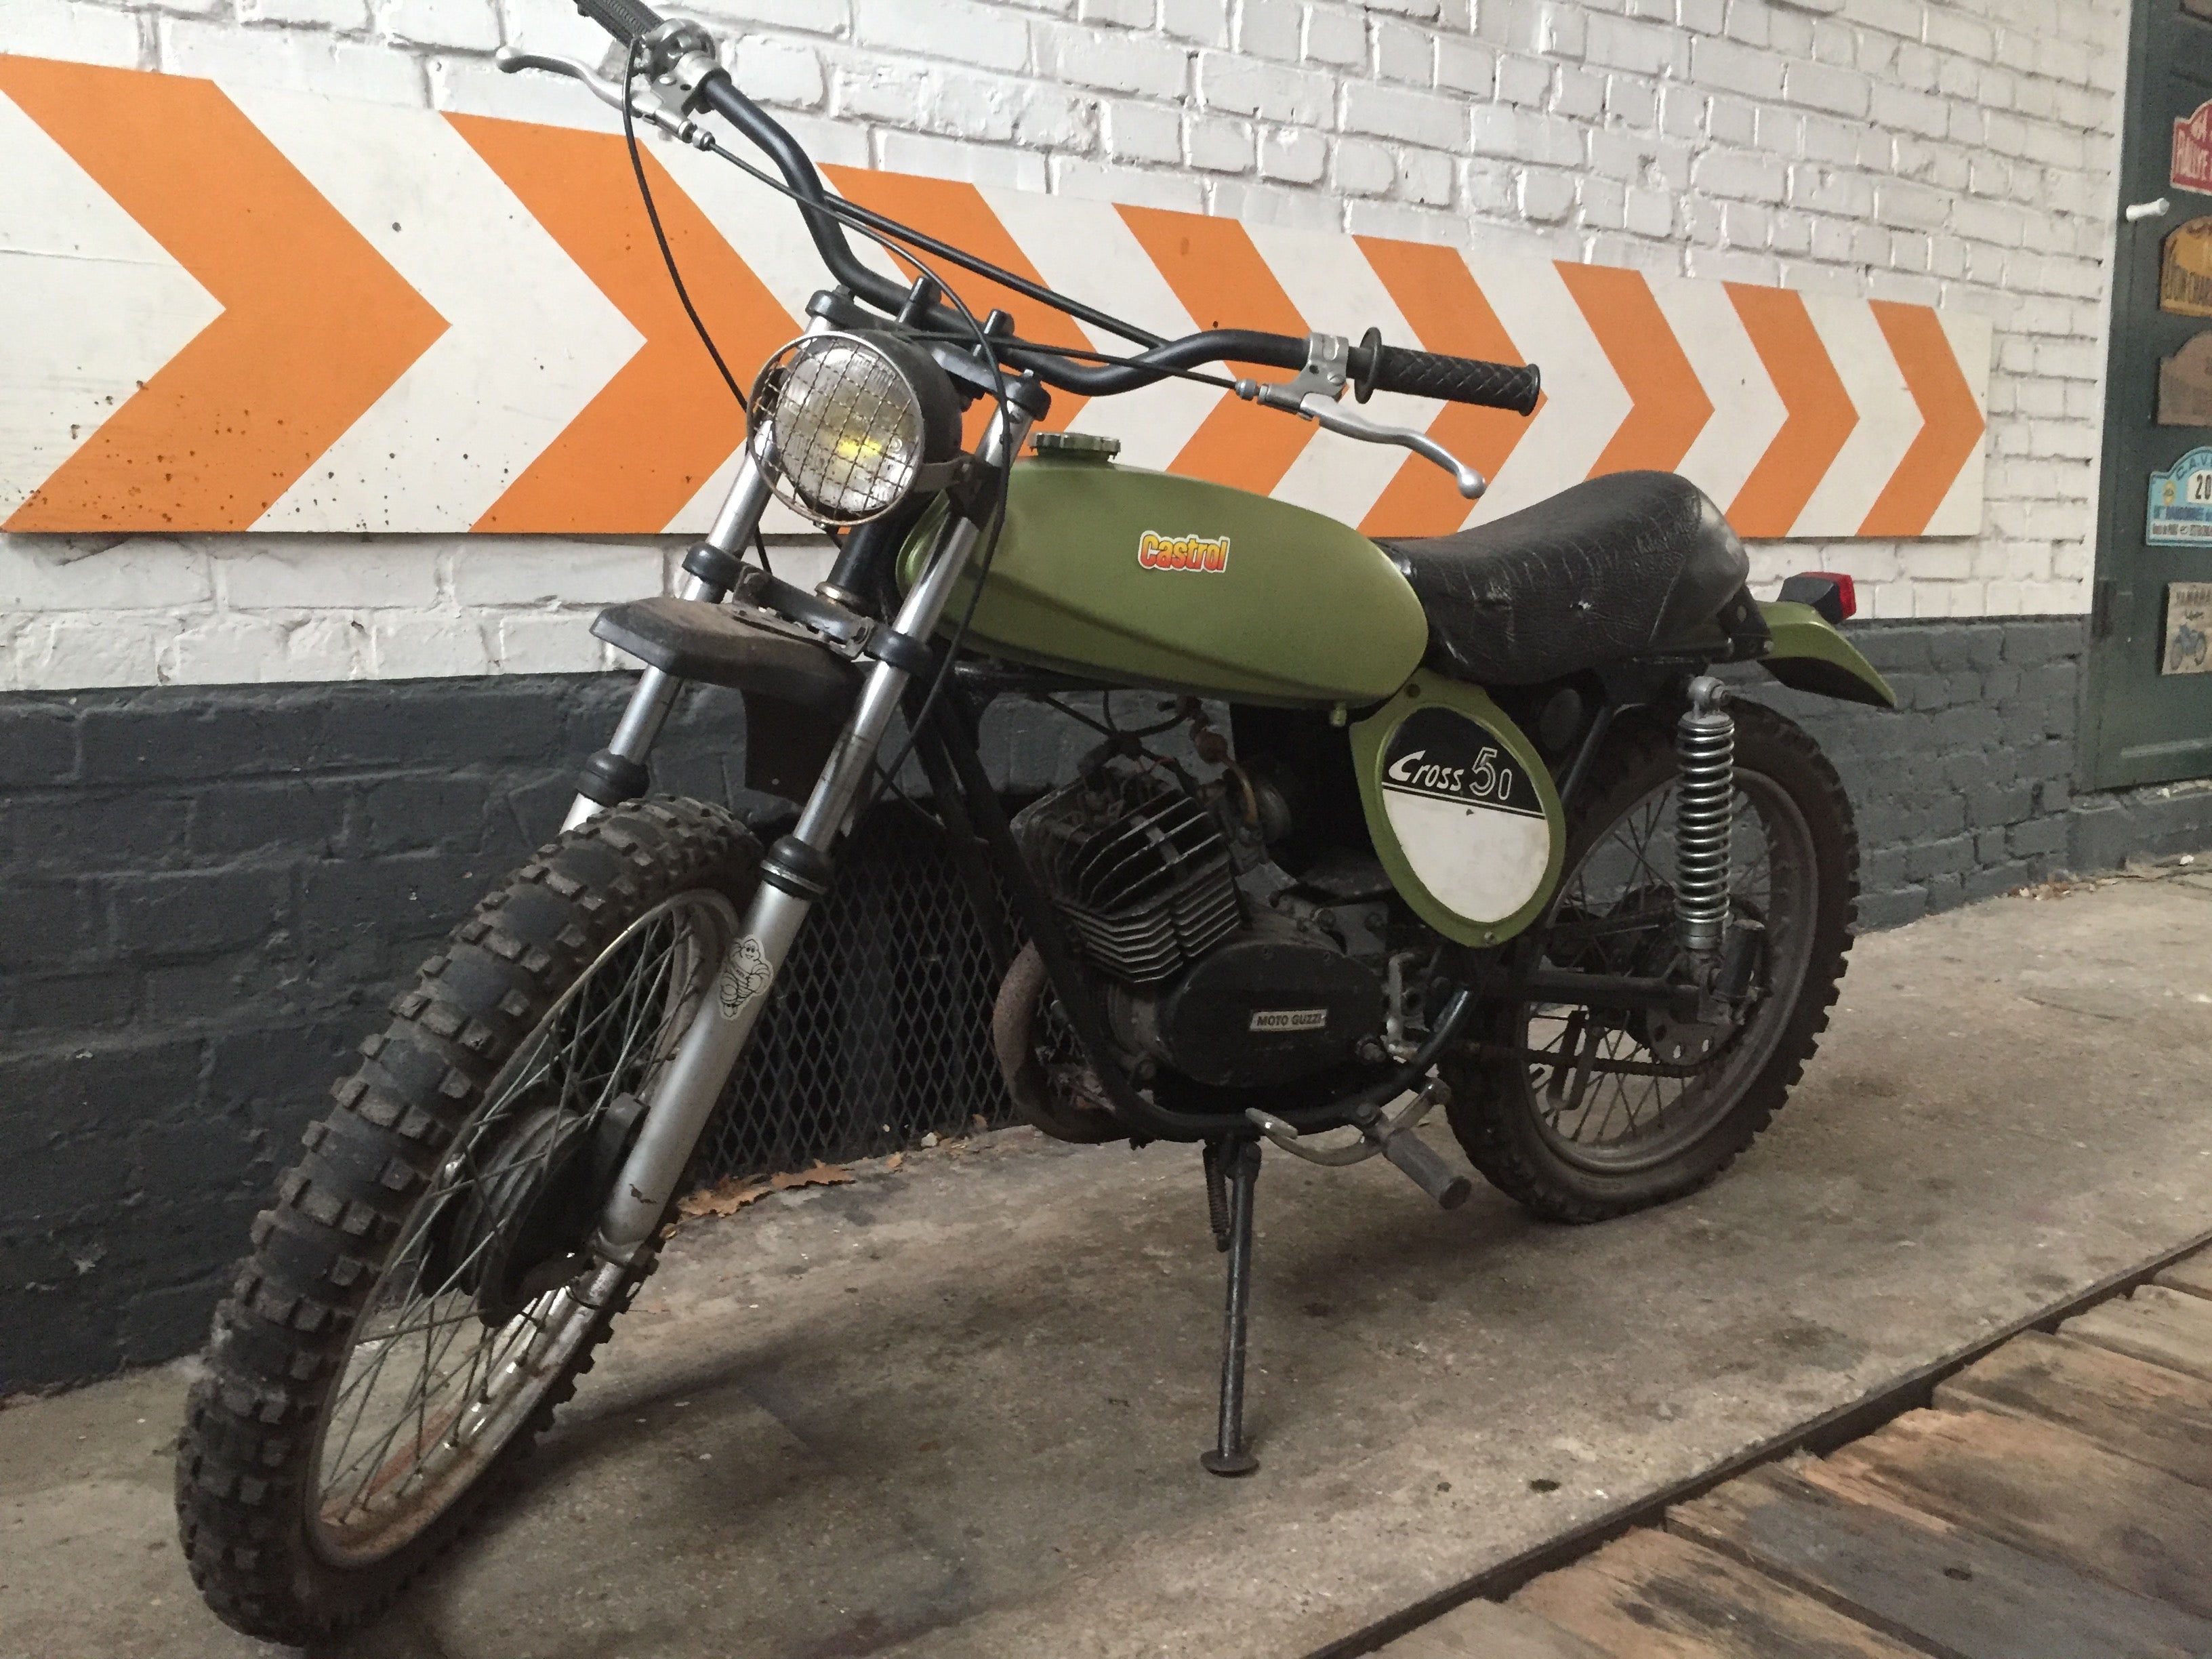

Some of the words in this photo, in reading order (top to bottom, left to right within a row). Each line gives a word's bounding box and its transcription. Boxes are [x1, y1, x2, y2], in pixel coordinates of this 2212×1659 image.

[1140, 533, 1229, 571] Castrol
[1388, 750, 1465, 792] Cross
[1469, 746, 1513, 800] 50
[1256, 1015, 1288, 1026] MOTO
[1290, 1013, 1322, 1025] GUZZI
